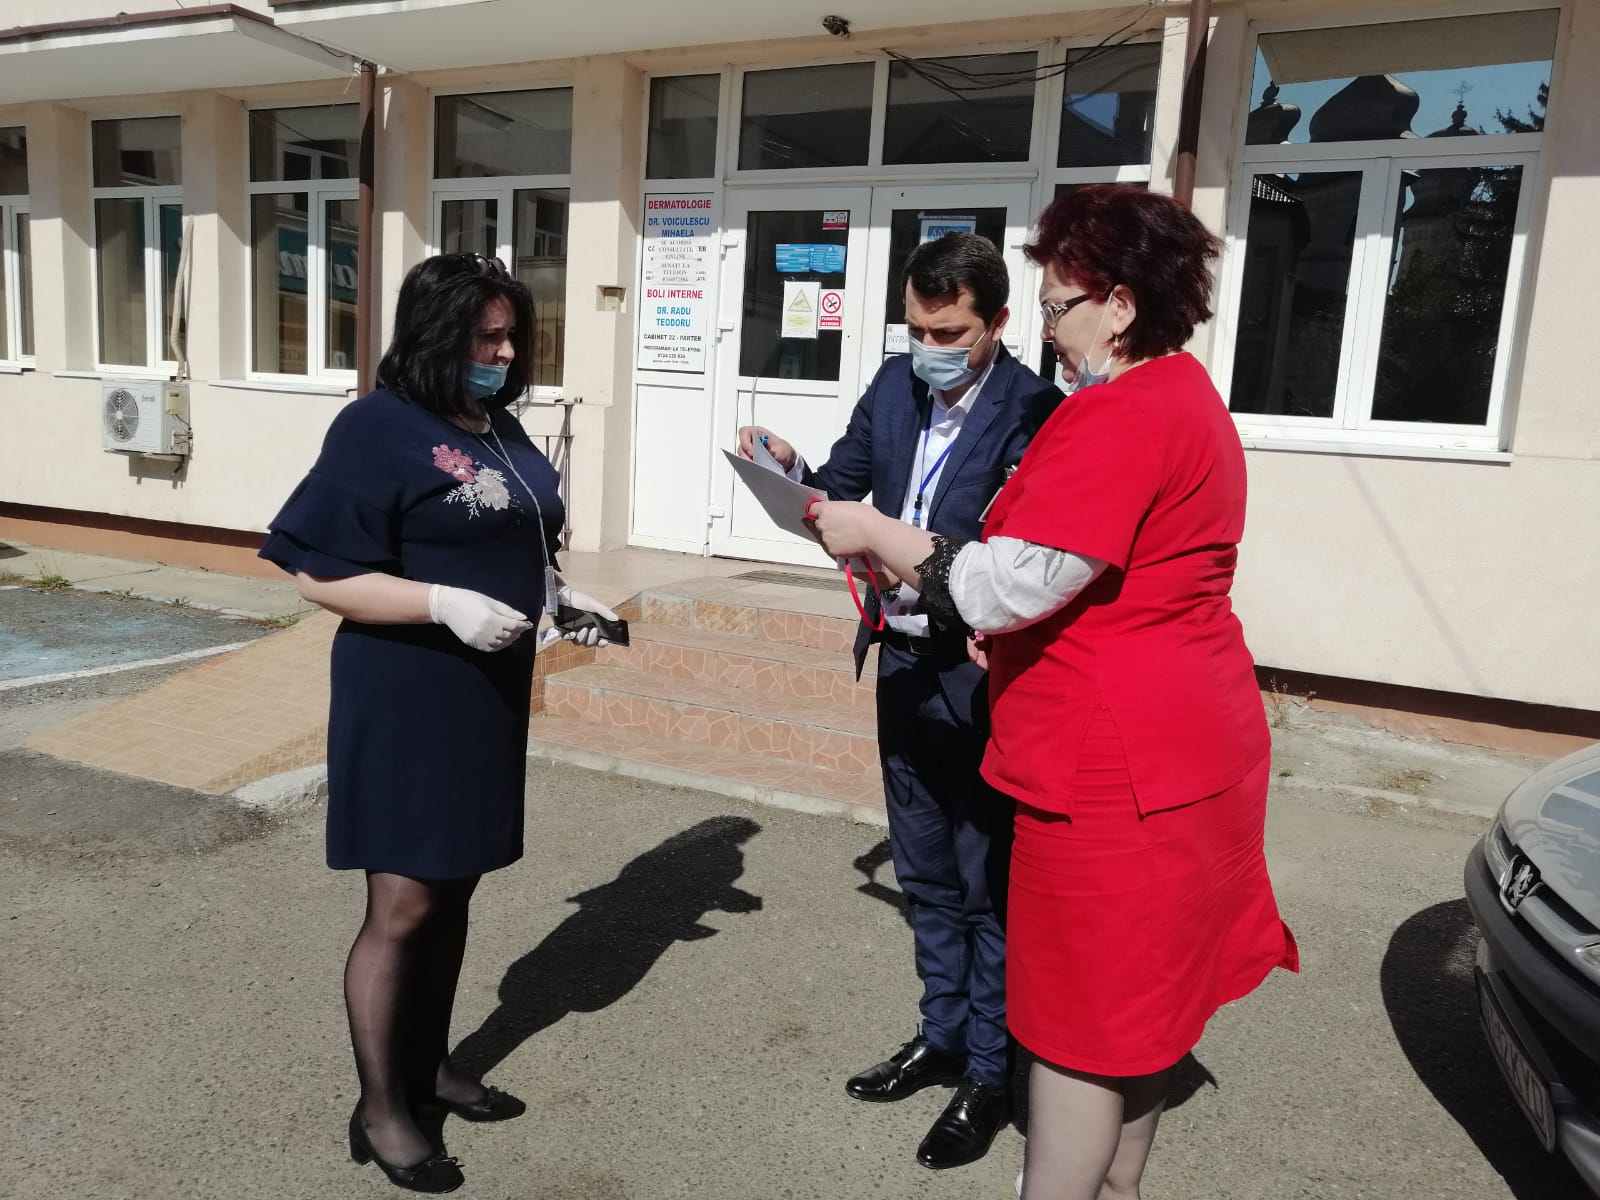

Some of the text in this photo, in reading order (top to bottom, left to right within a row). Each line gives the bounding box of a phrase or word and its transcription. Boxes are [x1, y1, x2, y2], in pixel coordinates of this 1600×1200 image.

[648, 200, 712, 210] DERMATOLOGIE
[648, 217, 710, 226] DR. VOICULESCU
[661, 229, 695, 238] MIHAELA
[647, 289, 703, 299] BOLI INTERNE
[657, 306, 691, 315] DR. RADU
[656, 318, 691, 328] TEODORU
